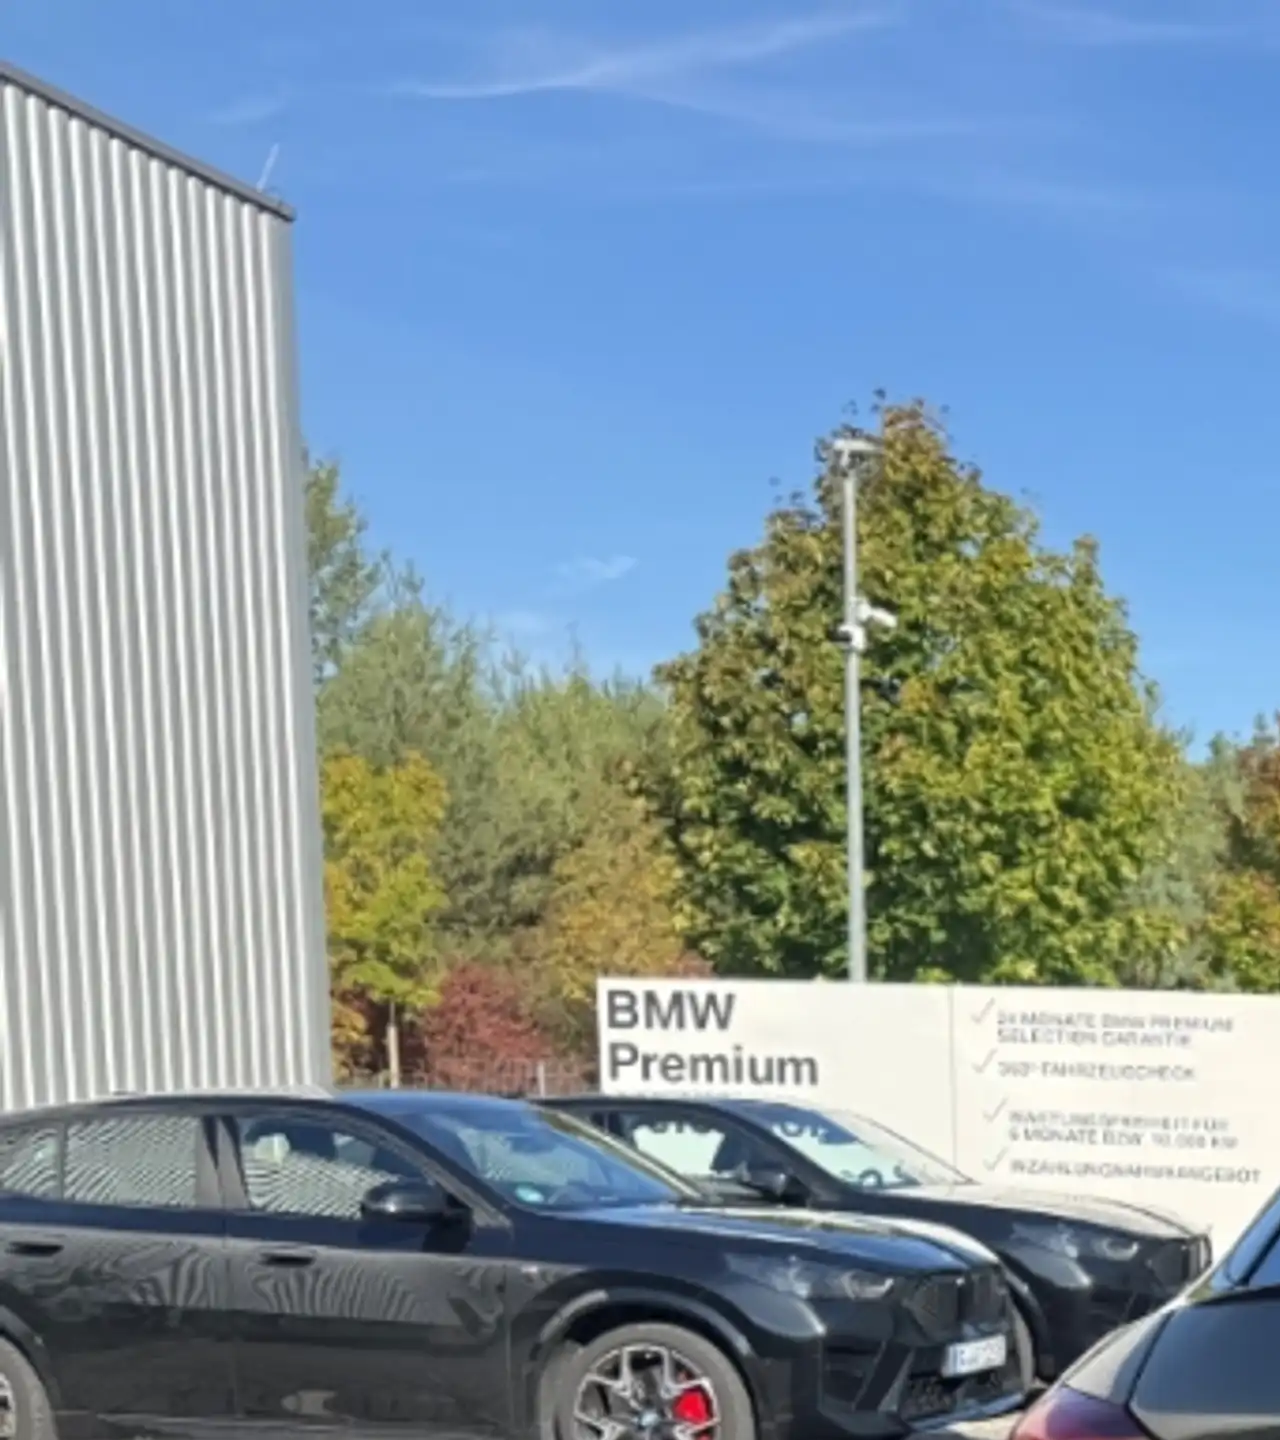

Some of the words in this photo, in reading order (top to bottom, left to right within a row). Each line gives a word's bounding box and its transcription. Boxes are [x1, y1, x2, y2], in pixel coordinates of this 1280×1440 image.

[607, 989, 735, 1031] BMW
[1020, 1010, 1096, 1029] MONATE
[608, 1042, 819, 1086] Premium
[1024, 1128, 1097, 1145] MONATE
